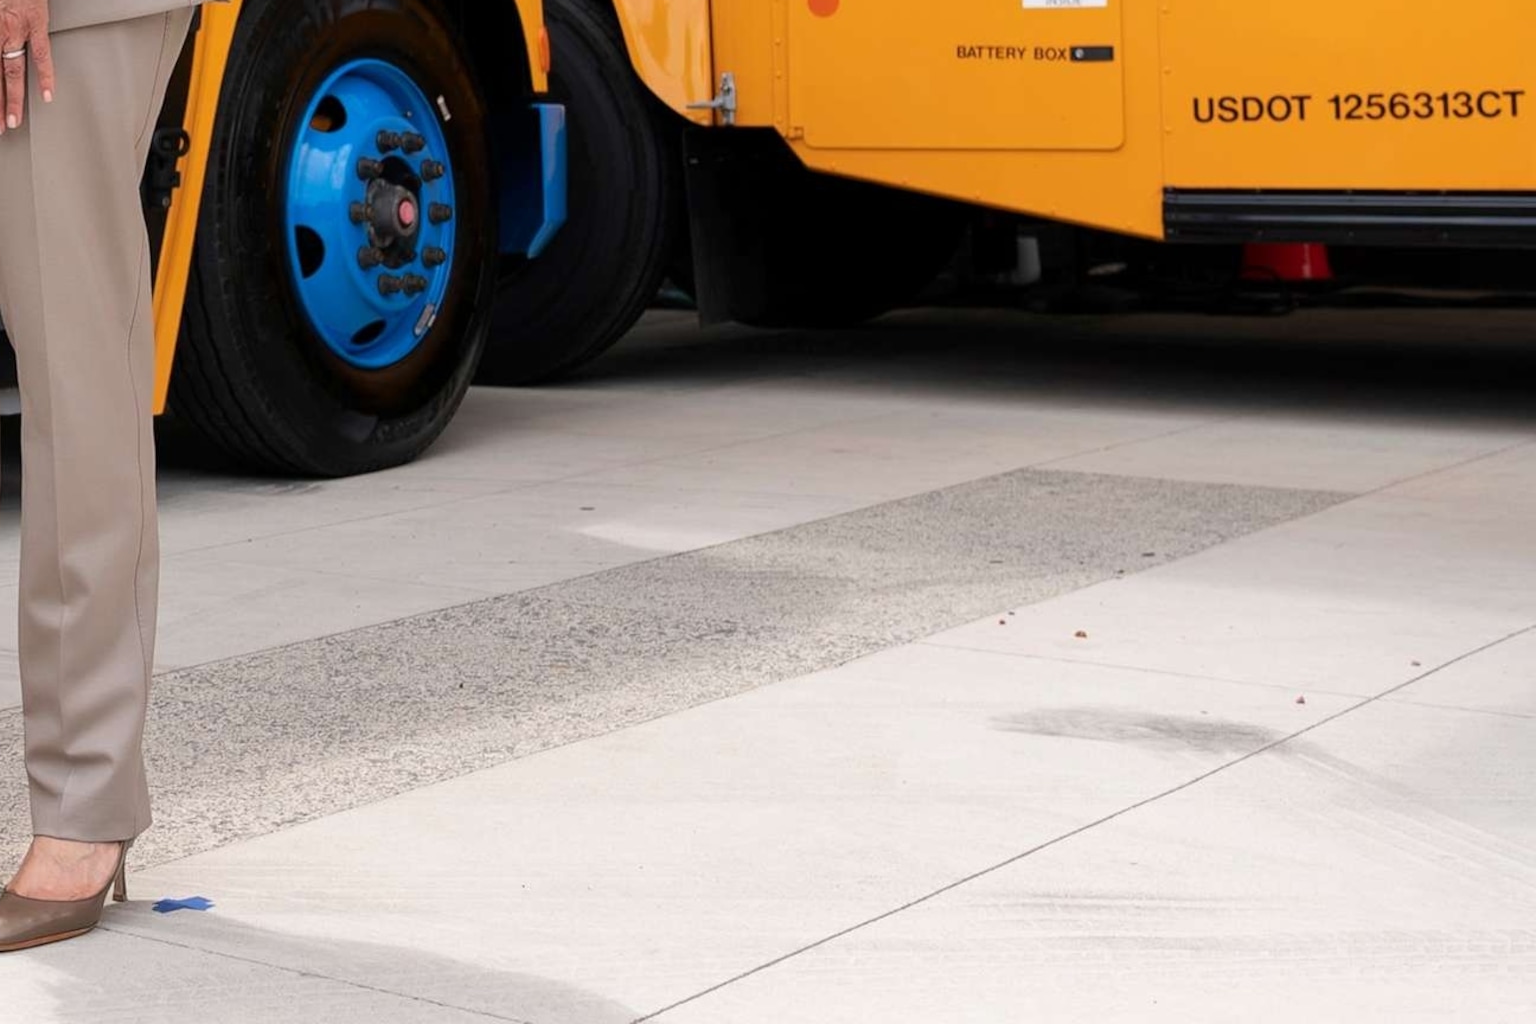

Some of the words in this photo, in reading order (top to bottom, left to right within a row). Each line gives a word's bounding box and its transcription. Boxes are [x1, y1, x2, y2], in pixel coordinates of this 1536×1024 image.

[957, 45, 1026, 60] BATTERY
[1034, 46, 1067, 61] BOX
[1193, 95, 1312, 123] USDOT
[1327, 90, 1526, 121] 1256313CT
